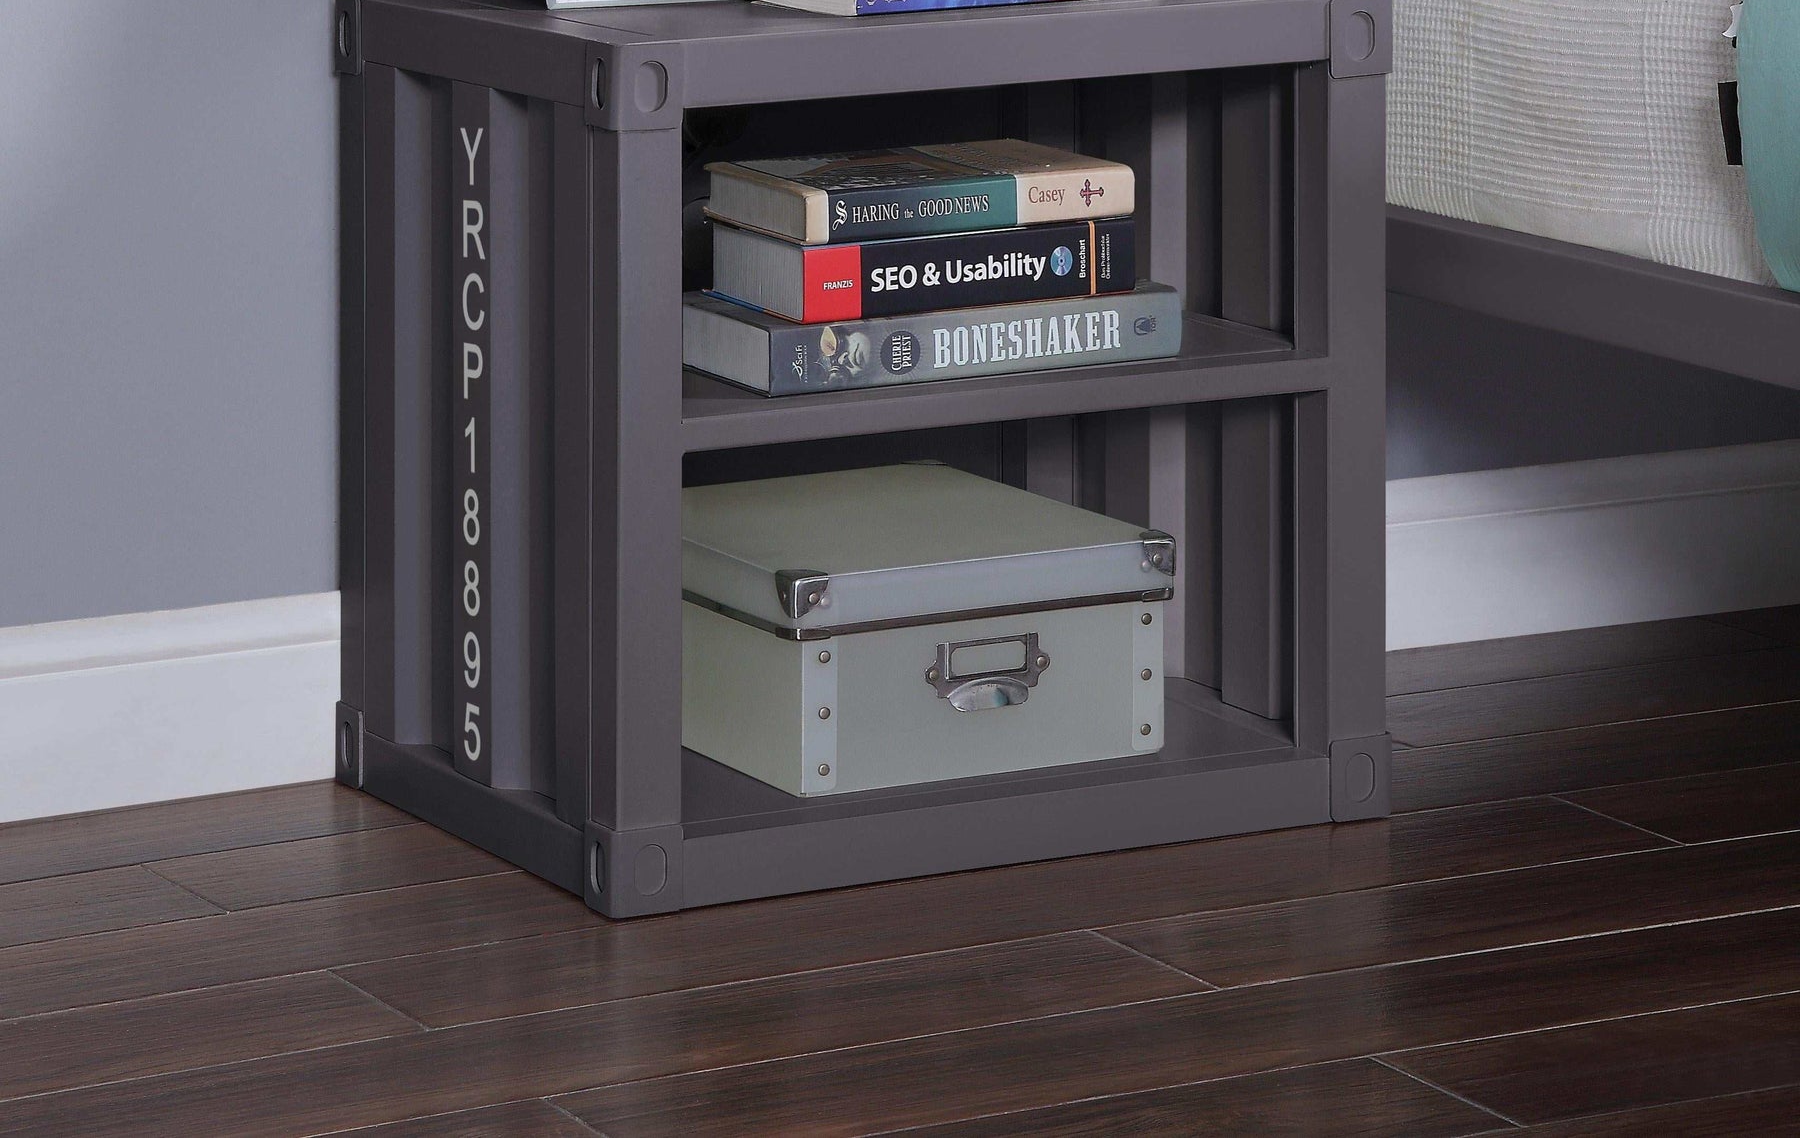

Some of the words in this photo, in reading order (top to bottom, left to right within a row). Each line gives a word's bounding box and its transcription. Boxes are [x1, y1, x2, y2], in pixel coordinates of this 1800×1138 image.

[904, 208, 914, 219] the
[918, 199, 953, 218] GOOD
[955, 195, 989, 214] NEWS
[1028, 186, 1066, 206] Casey
[870, 265, 918, 293] SEO
[922, 262, 941, 288] &
[945, 251, 1047, 282] Usability
[1079, 239, 1087, 279] Broschart
[823, 279, 854, 291] FRANZIS
[891, 335, 902, 371] CHERIE
[902, 335, 912, 367] PRIEST
[932, 310, 1121, 369] BONESHAKER
